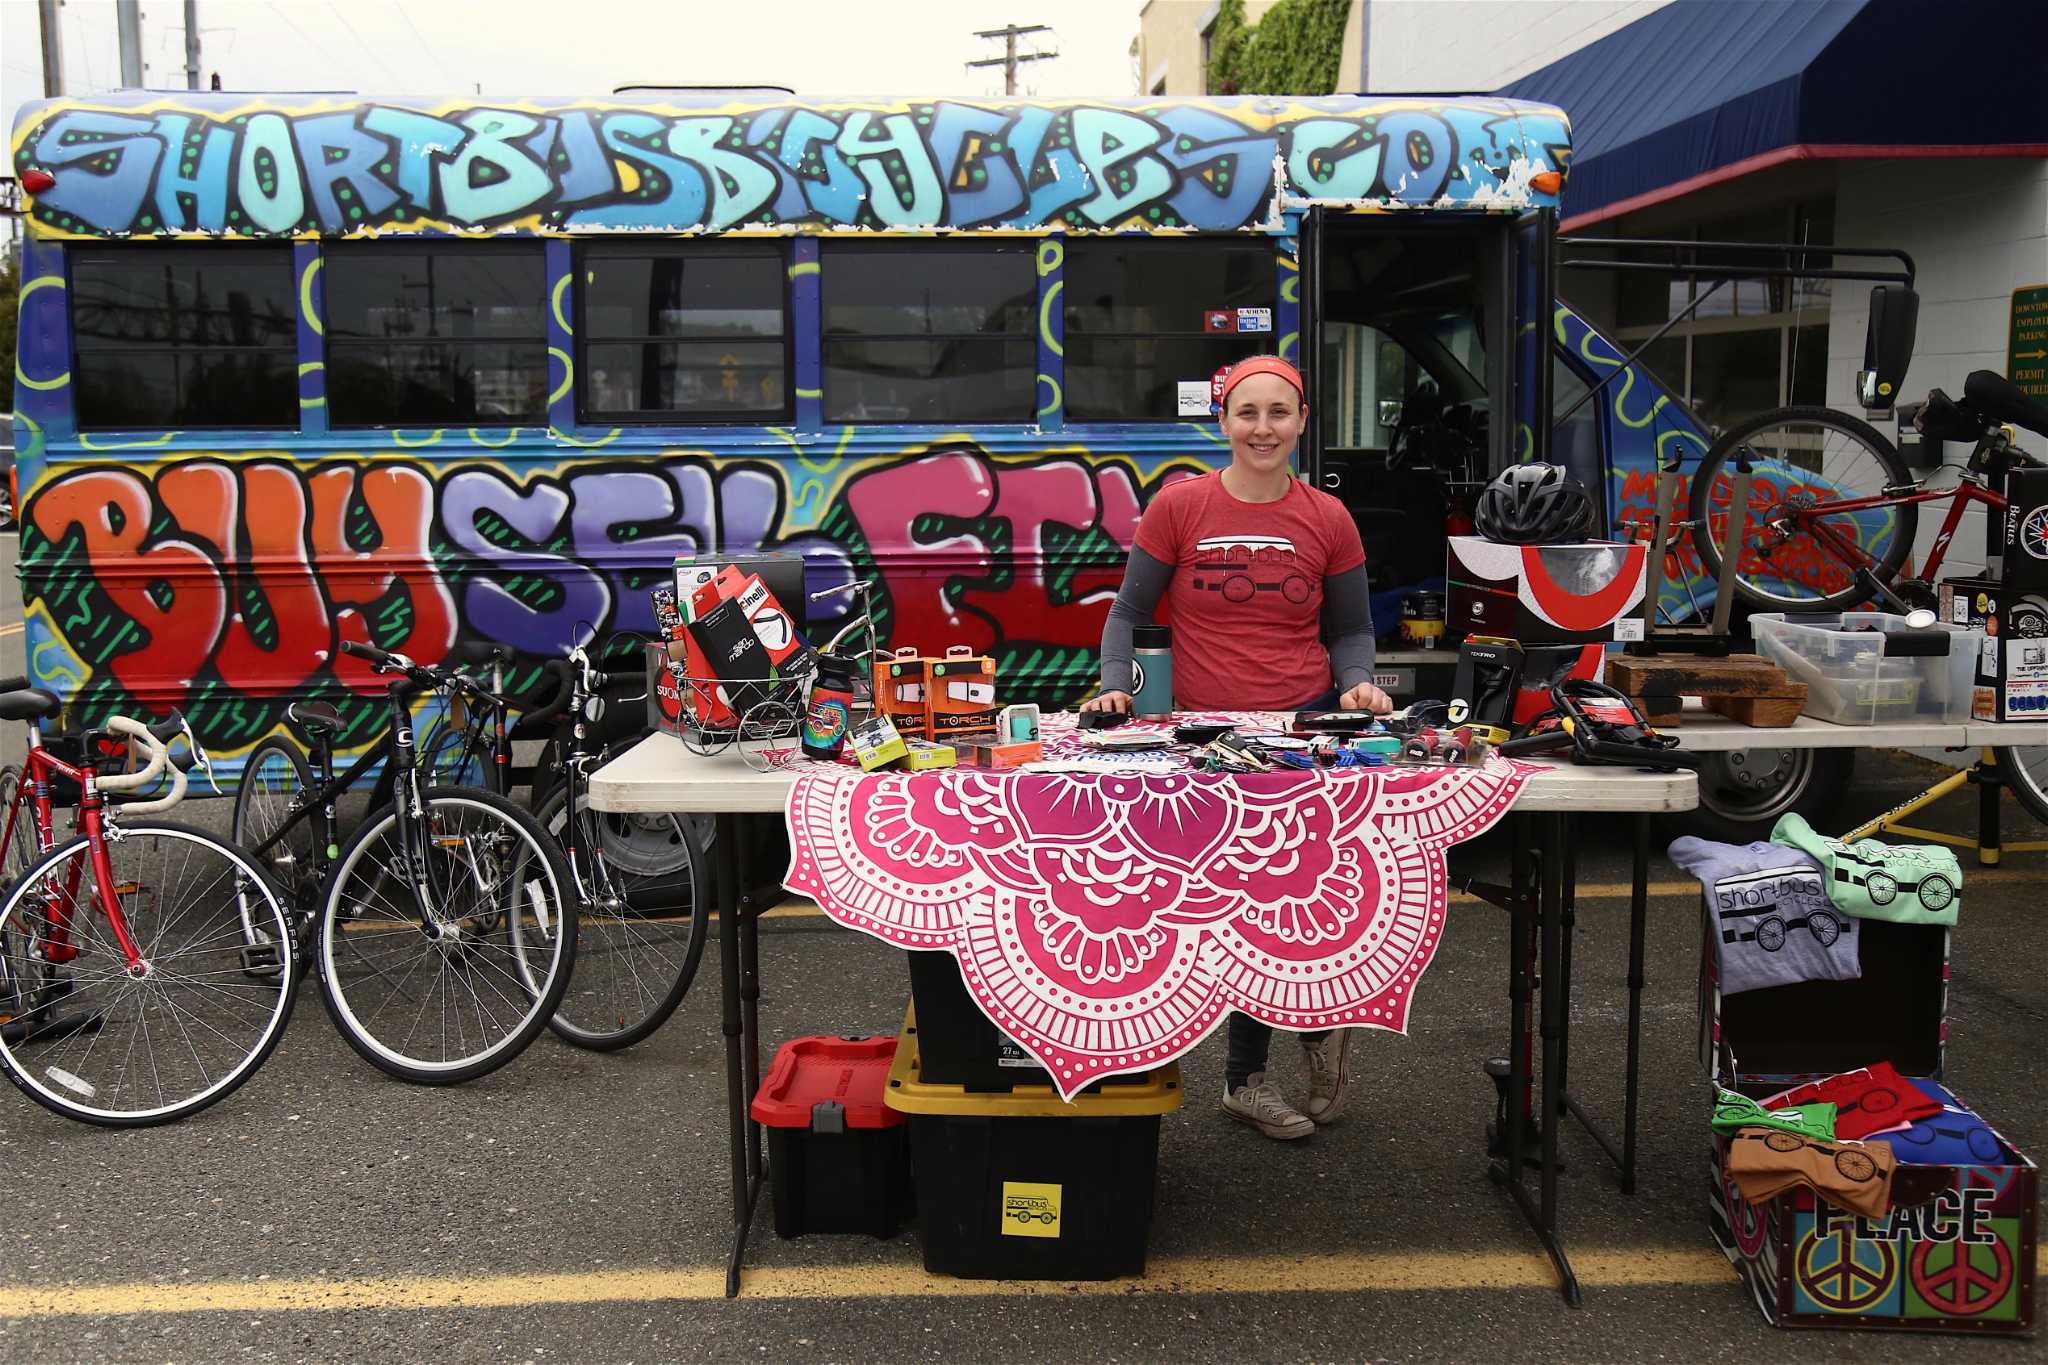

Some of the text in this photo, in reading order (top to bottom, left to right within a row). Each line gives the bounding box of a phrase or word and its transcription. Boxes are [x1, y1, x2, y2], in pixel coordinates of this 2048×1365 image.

[1376, 676, 1397, 685] STEP
[657, 685, 680, 700] SUOM
[896, 716, 924, 726] TOR
[940, 715, 992, 726] TORCH
[1719, 877, 1820, 909] shortbus
[1002, 1046, 1012, 1055] 27
